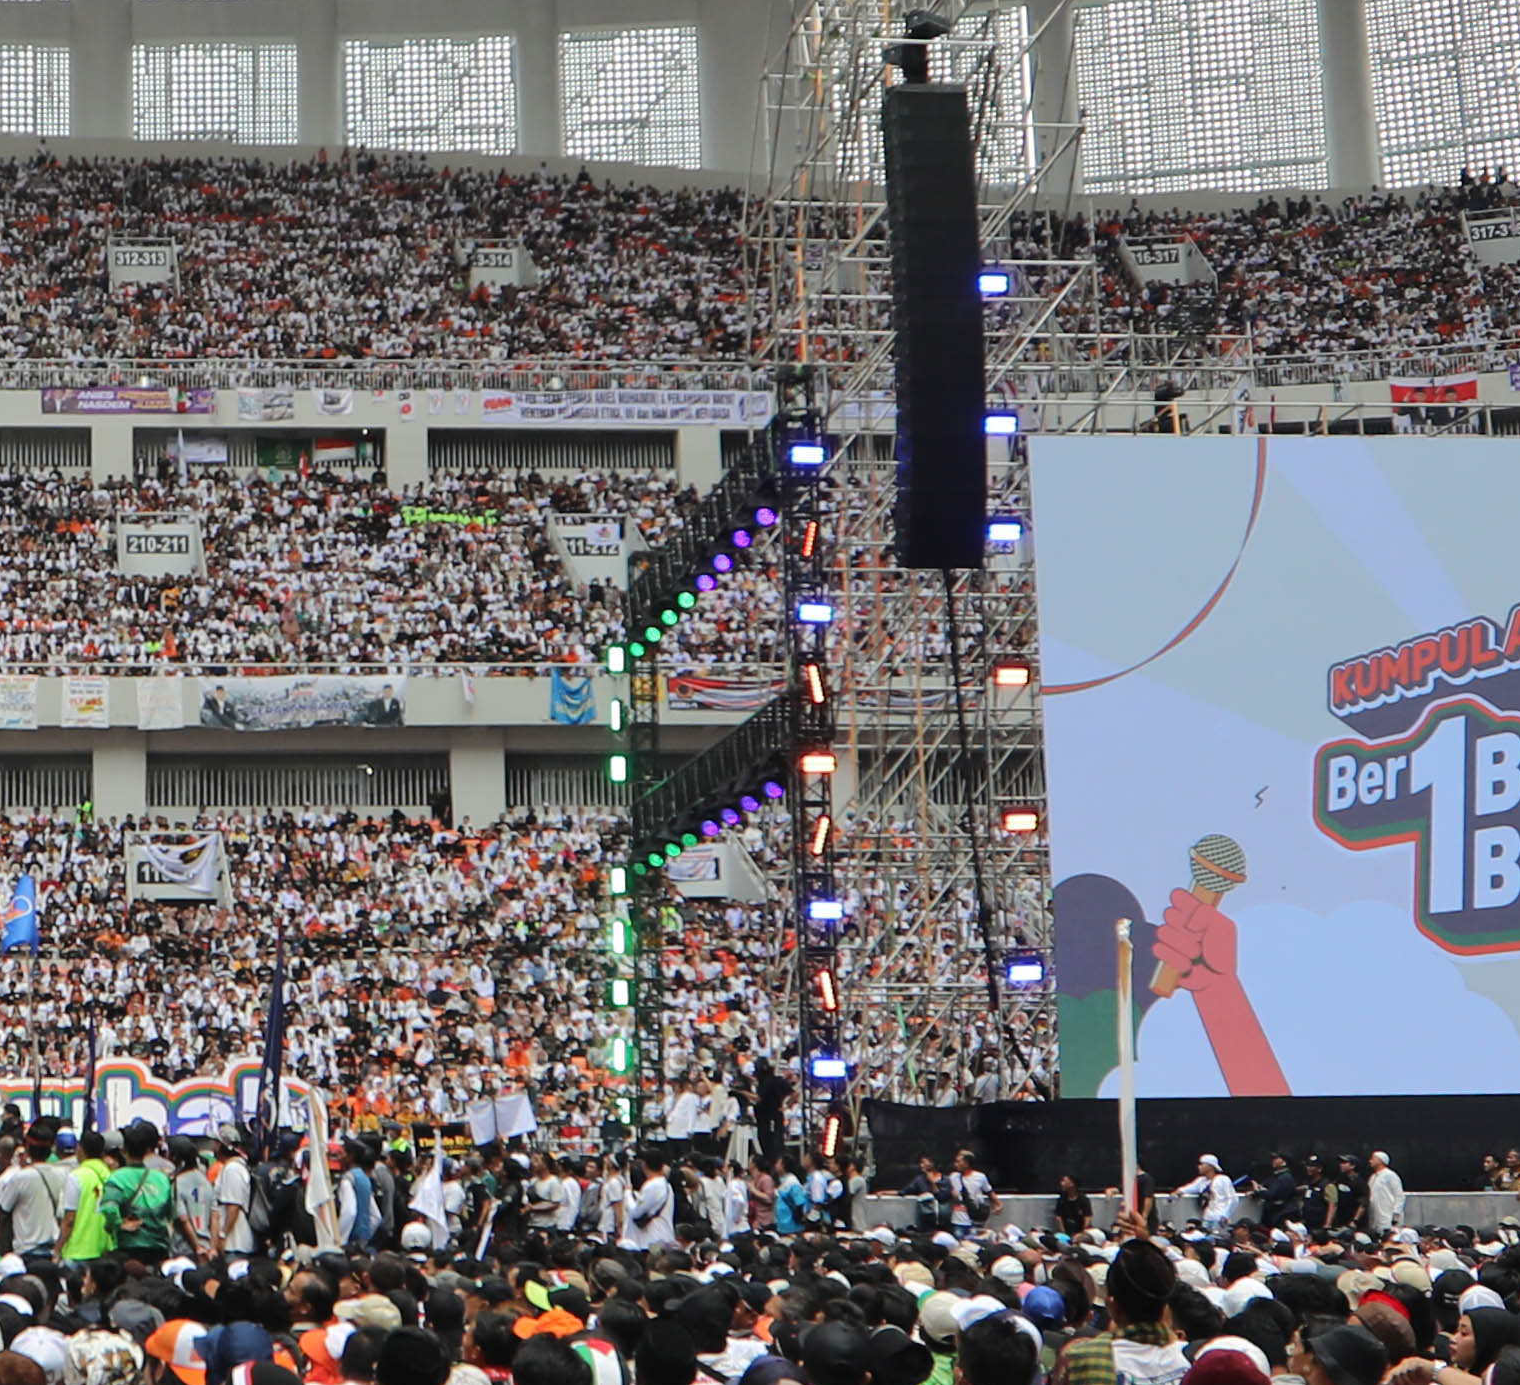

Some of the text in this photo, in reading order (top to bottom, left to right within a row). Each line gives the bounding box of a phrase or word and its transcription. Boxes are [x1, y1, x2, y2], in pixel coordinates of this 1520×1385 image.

[115, 251, 166, 266] 312-313
[477, 252, 512, 267] 3-314
[1137, 247, 1177, 264] 16-317
[128, 536, 187, 553] 210-211
[567, 538, 619, 556] 11-212
[1331, 620, 1496, 707] KUMPUL
